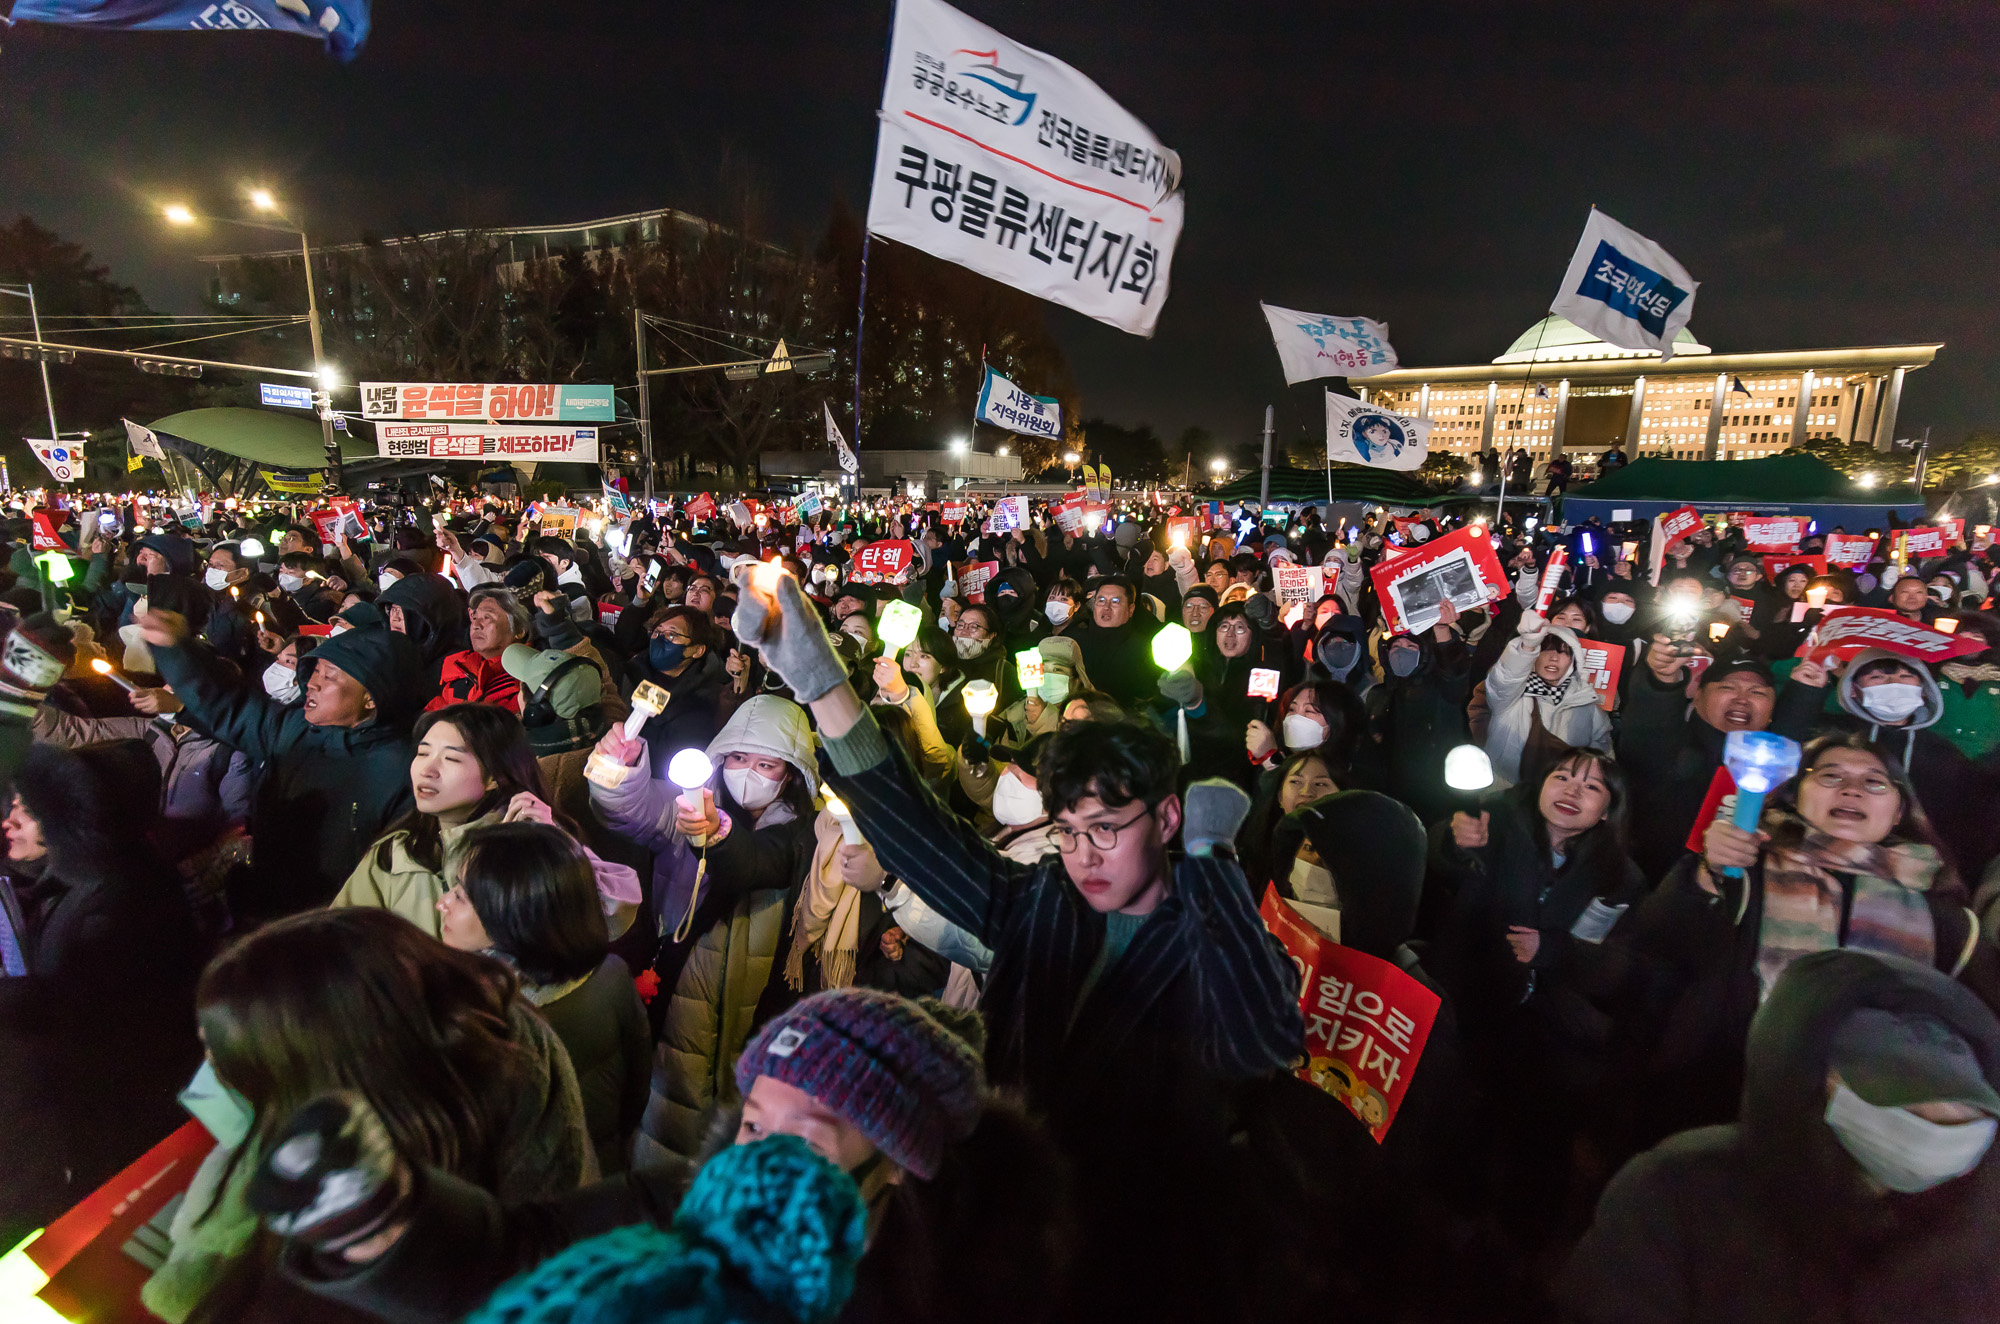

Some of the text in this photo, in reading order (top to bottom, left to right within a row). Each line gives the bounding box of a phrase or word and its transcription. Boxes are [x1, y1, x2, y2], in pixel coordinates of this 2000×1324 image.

[912, 66, 1010, 125] 공공운수노조
[895, 144, 1160, 305] 쿠팡물류센터지회
[1594, 259, 1672, 318] 조국혁신당
[366, 386, 398, 401] 내란
[367, 401, 398, 415] 수괴
[402, 384, 556, 419] 윤석열 하야!
[1007, 389, 1045, 416] 시흥을
[992, 402, 1055, 435] 지역위원회
[387, 435, 575, 457] 현행범 윤석열을 체포하라!
[861, 547, 902, 570] 탄핵
[1317, 974, 1416, 1055] 힘으로
[1305, 1011, 1402, 1094] 지키자
